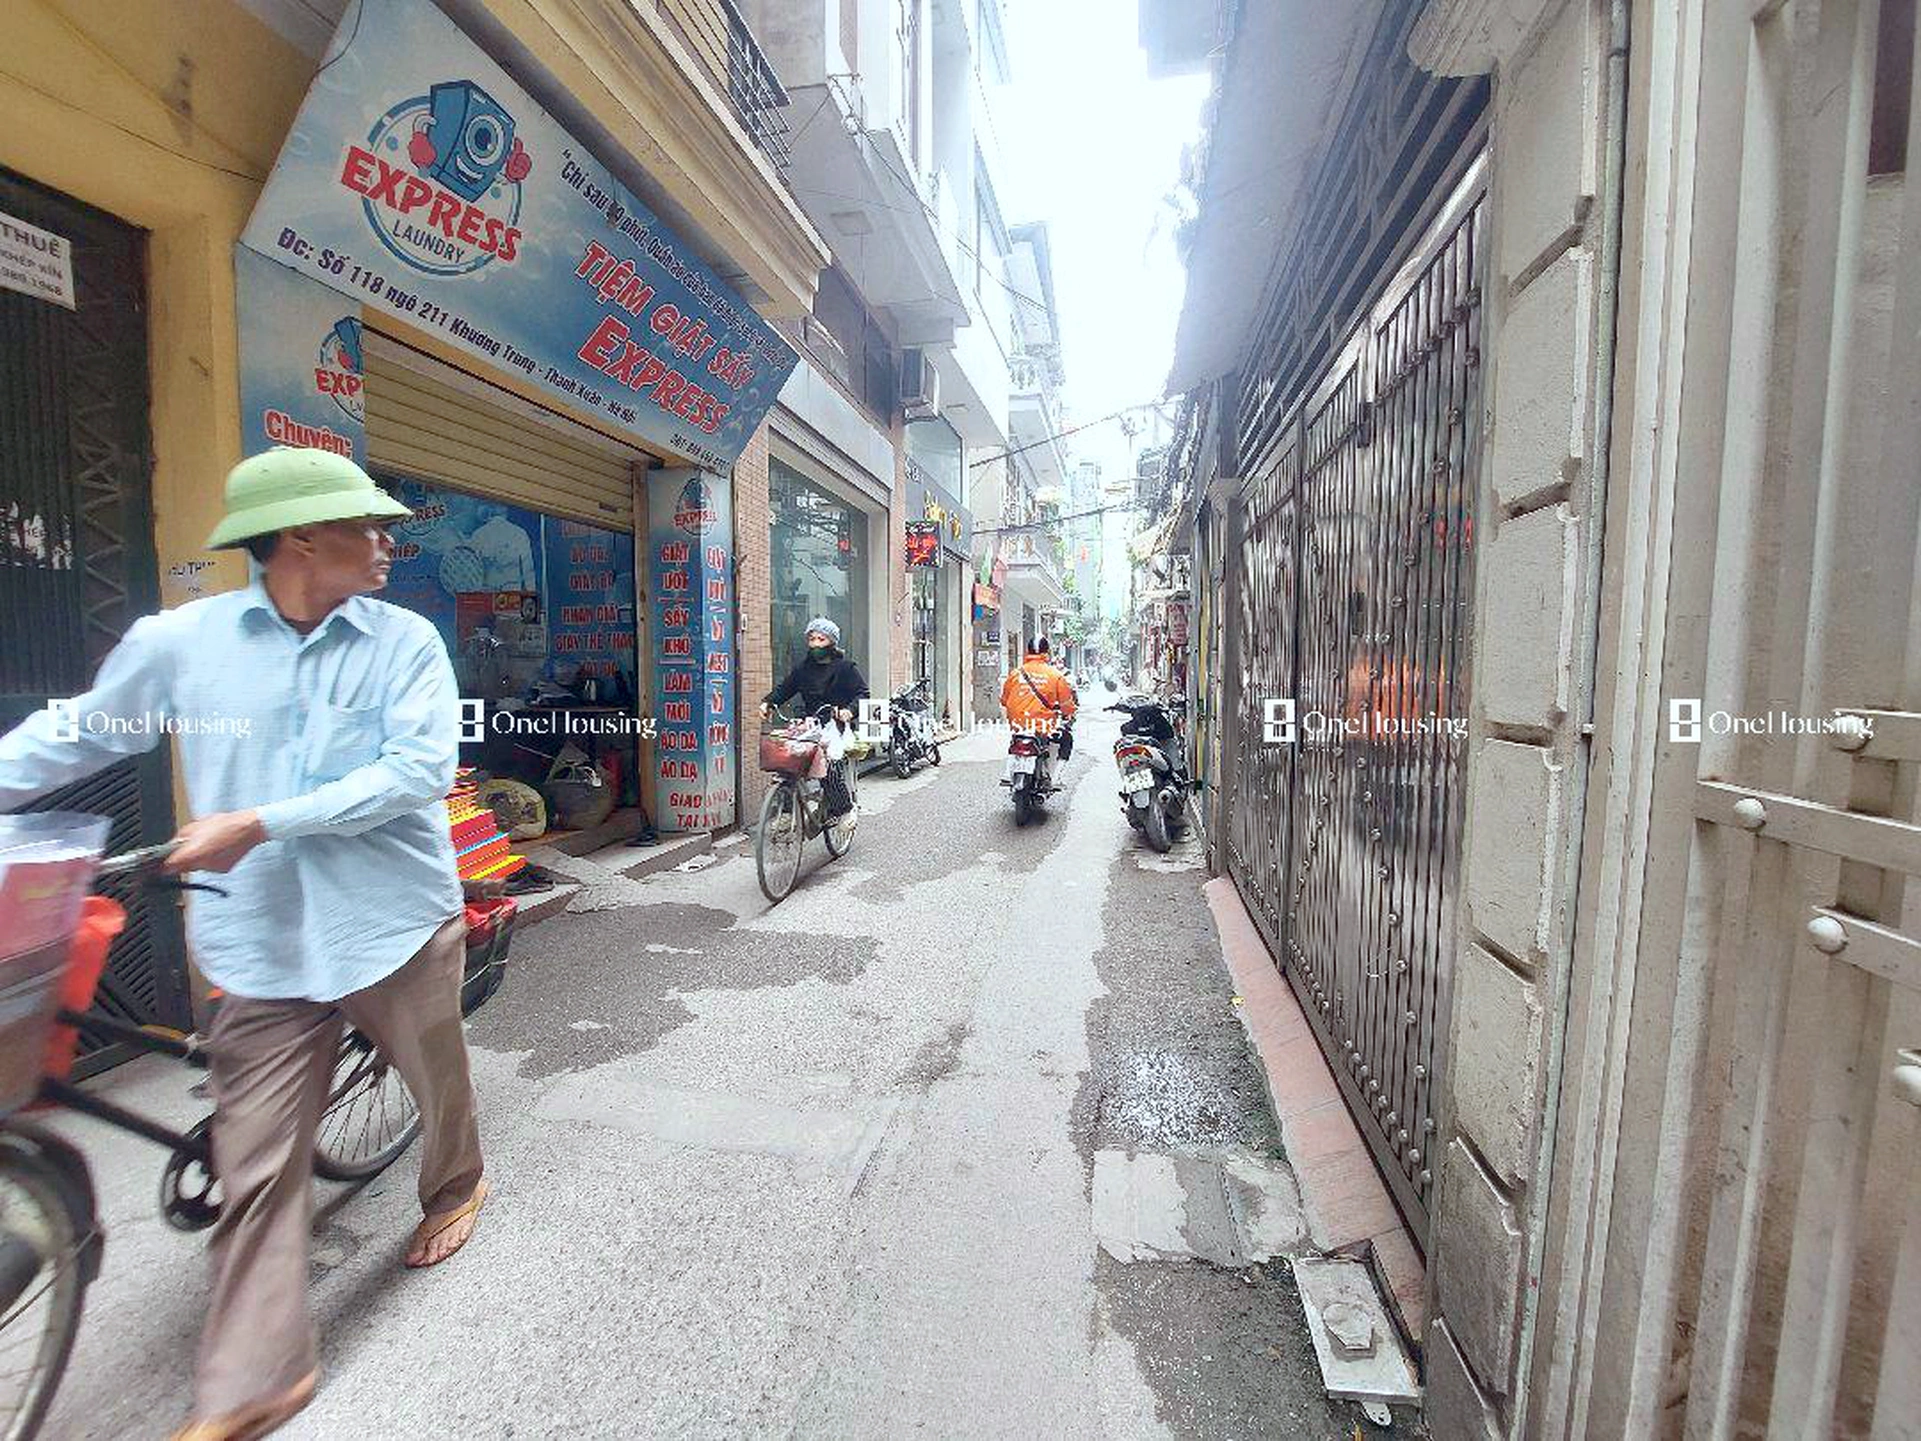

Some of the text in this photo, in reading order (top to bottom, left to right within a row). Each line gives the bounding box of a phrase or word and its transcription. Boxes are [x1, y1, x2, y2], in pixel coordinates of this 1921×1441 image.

[341, 145, 522, 261] EXPRESS
[392, 219, 466, 264] LAUNDRY
[317, 248, 350, 276] Số
[350, 266, 384, 295] 118
[418, 302, 449, 326] 211
[450, 317, 500, 358] Khương
[575, 240, 656, 317] TIỆM
[650, 304, 717, 362] GIẶT
[708, 347, 756, 390] SẤY
[315, 367, 364, 397] EXP
[577, 315, 731, 434] EXPRESS
